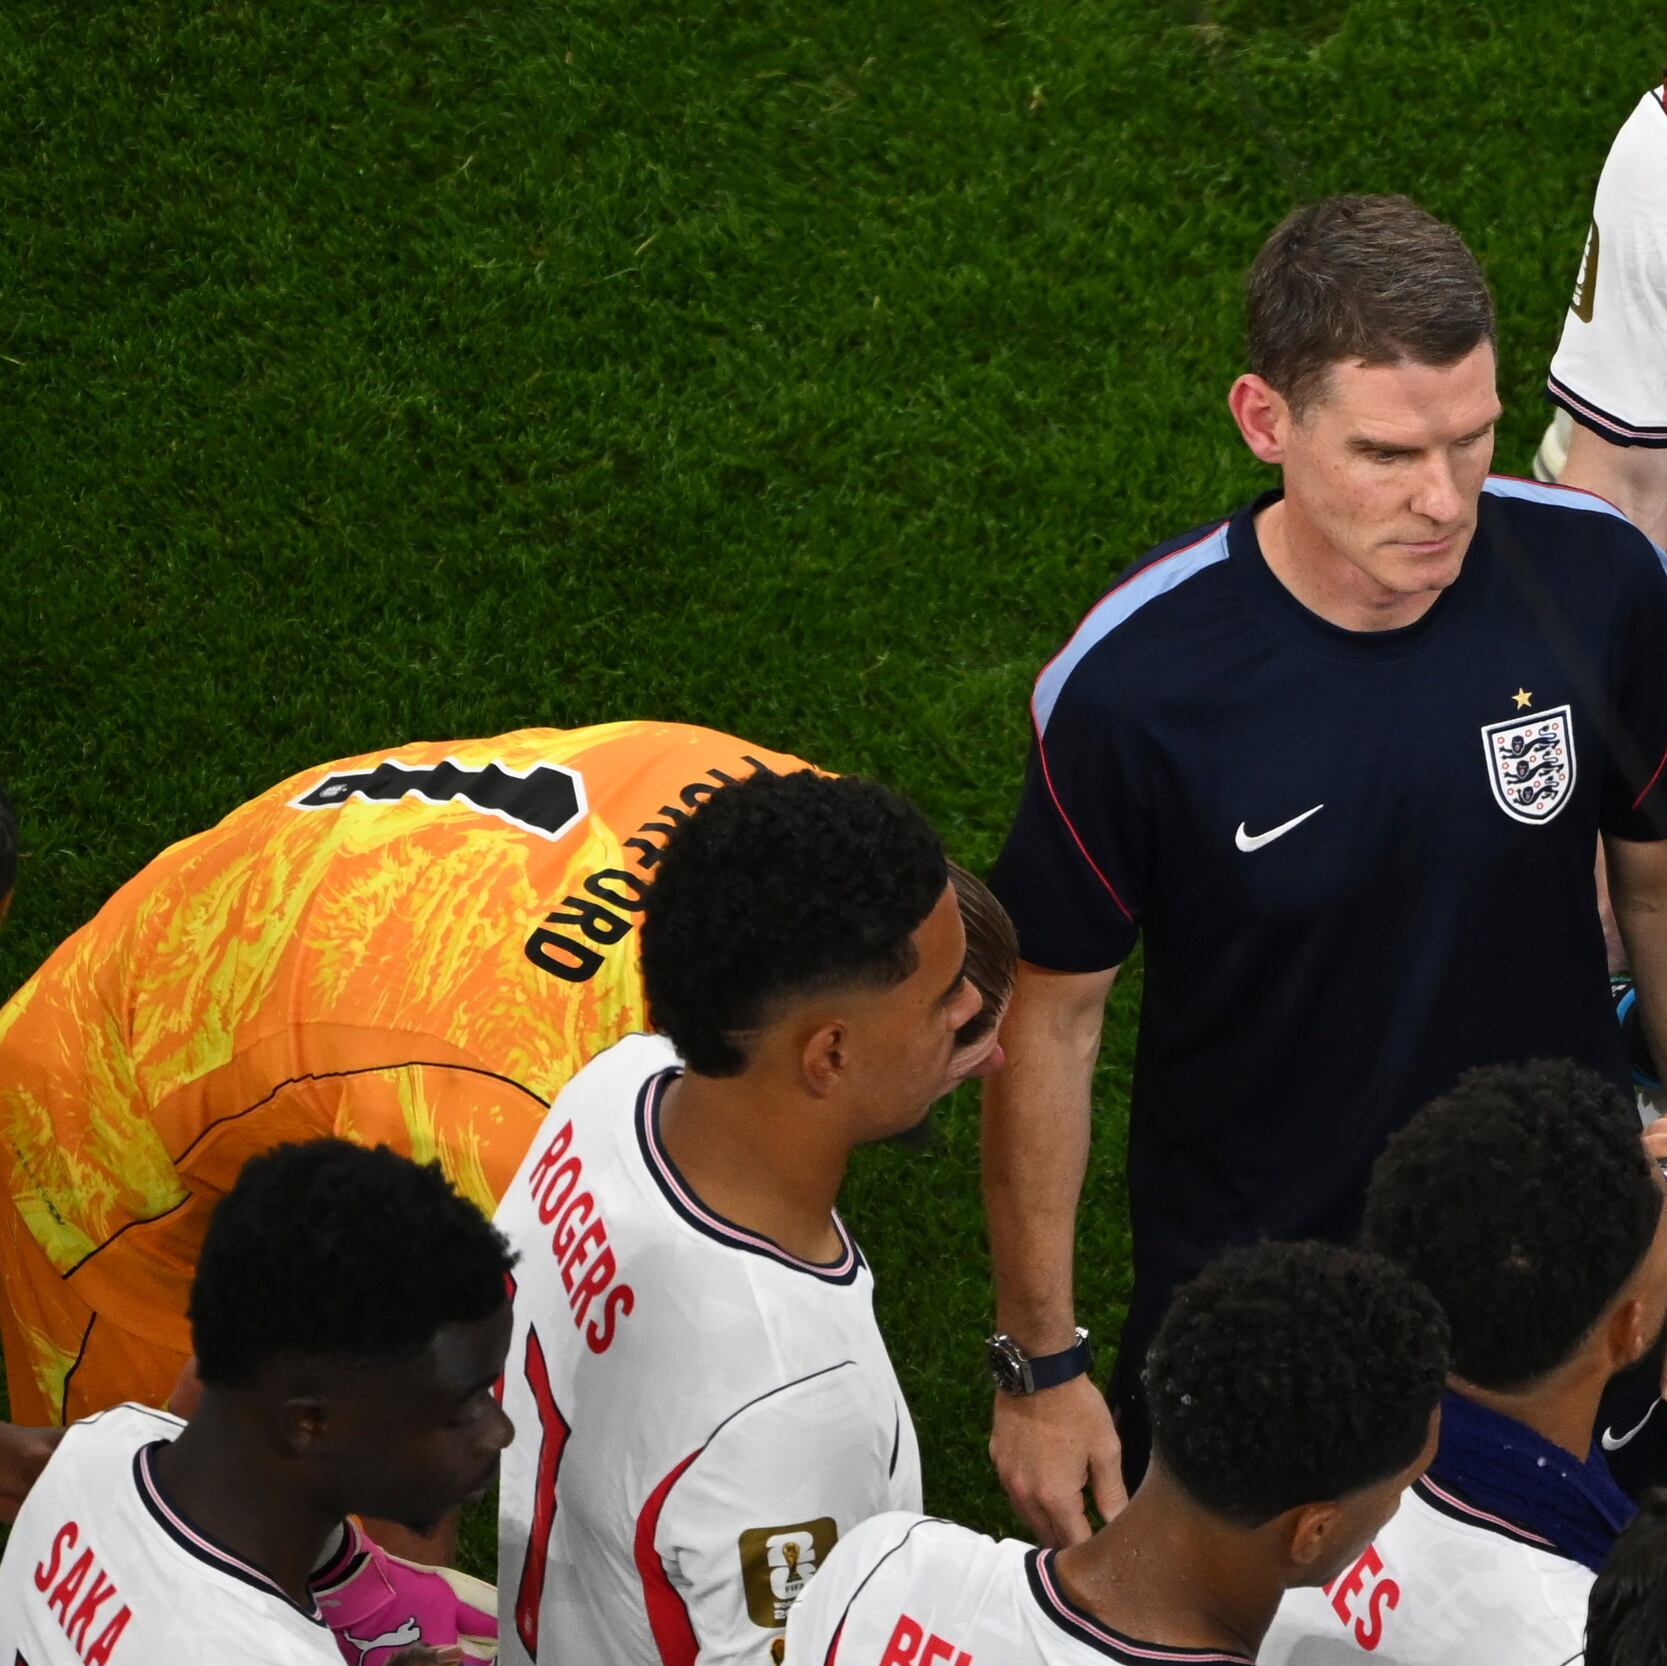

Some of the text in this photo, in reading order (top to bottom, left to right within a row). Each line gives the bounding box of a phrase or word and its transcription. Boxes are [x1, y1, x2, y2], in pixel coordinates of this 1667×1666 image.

[288, 760, 588, 842] 1
[528, 1118, 635, 1355] ROGERS
[1321, 1541, 1401, 1652] ES
